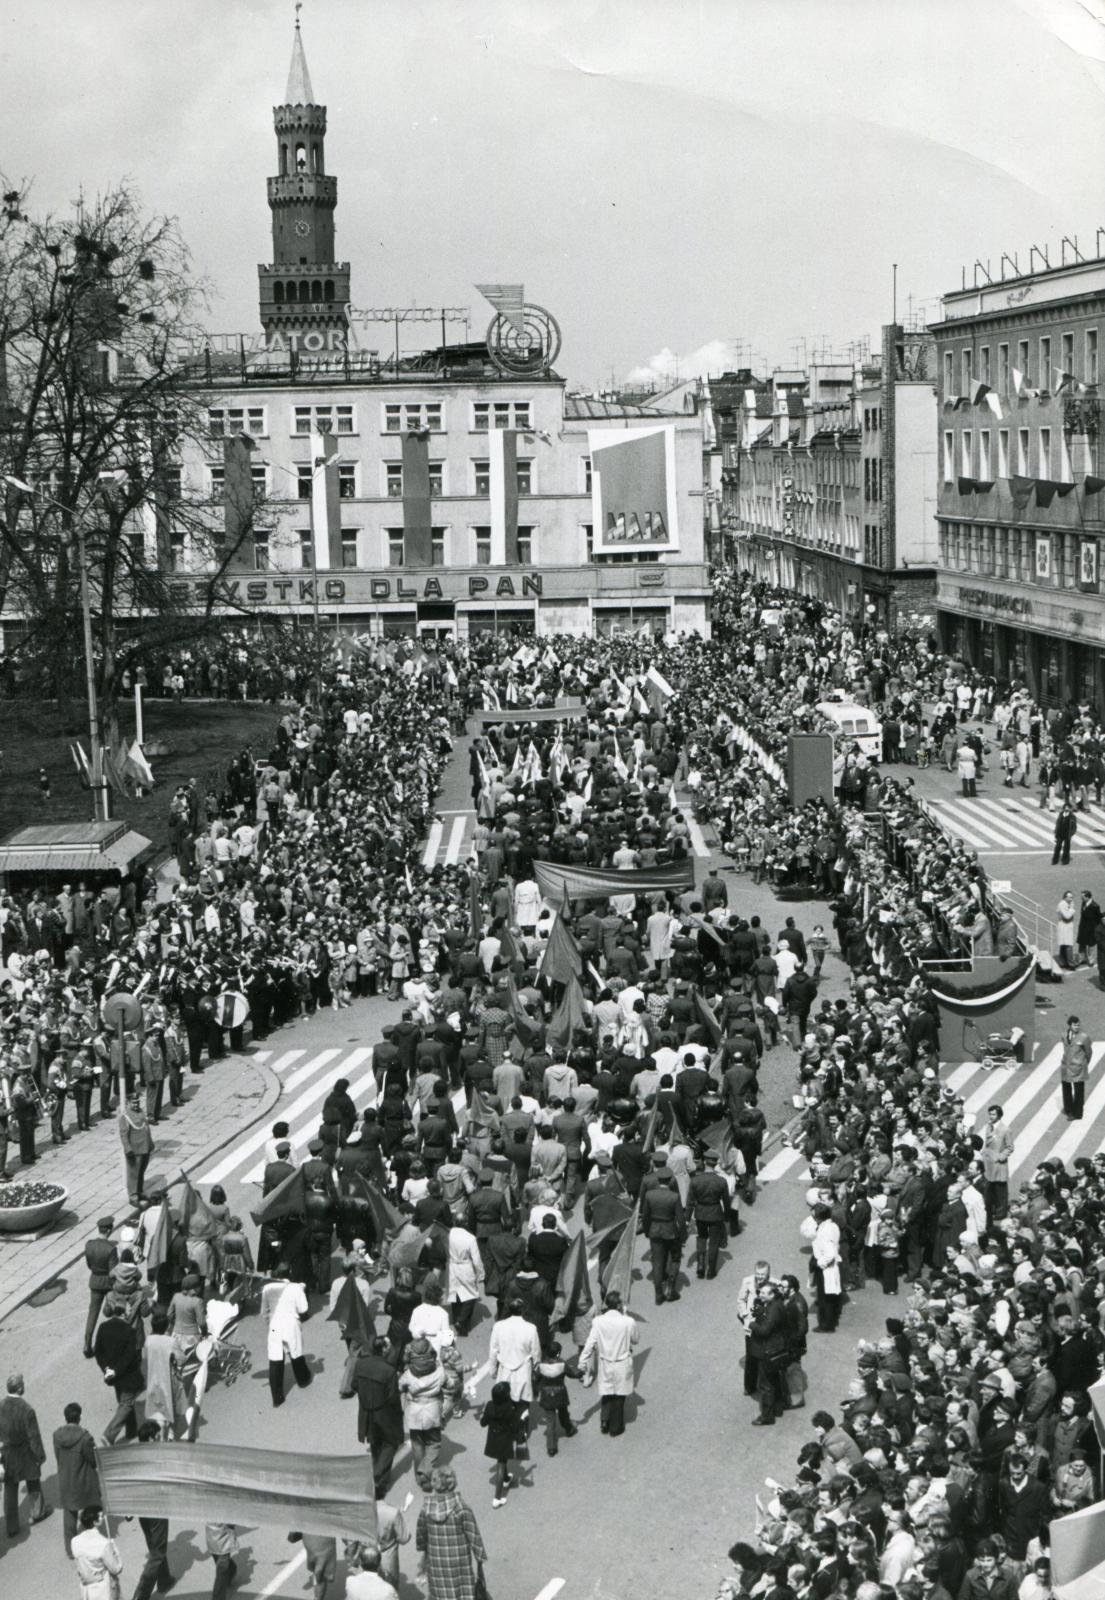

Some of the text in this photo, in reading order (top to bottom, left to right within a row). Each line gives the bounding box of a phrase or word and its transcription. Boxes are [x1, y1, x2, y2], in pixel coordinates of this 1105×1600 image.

[607, 511, 669, 540] MAJA
[371, 576, 443, 599] DLA
[468, 572, 543, 597] PAŃ
